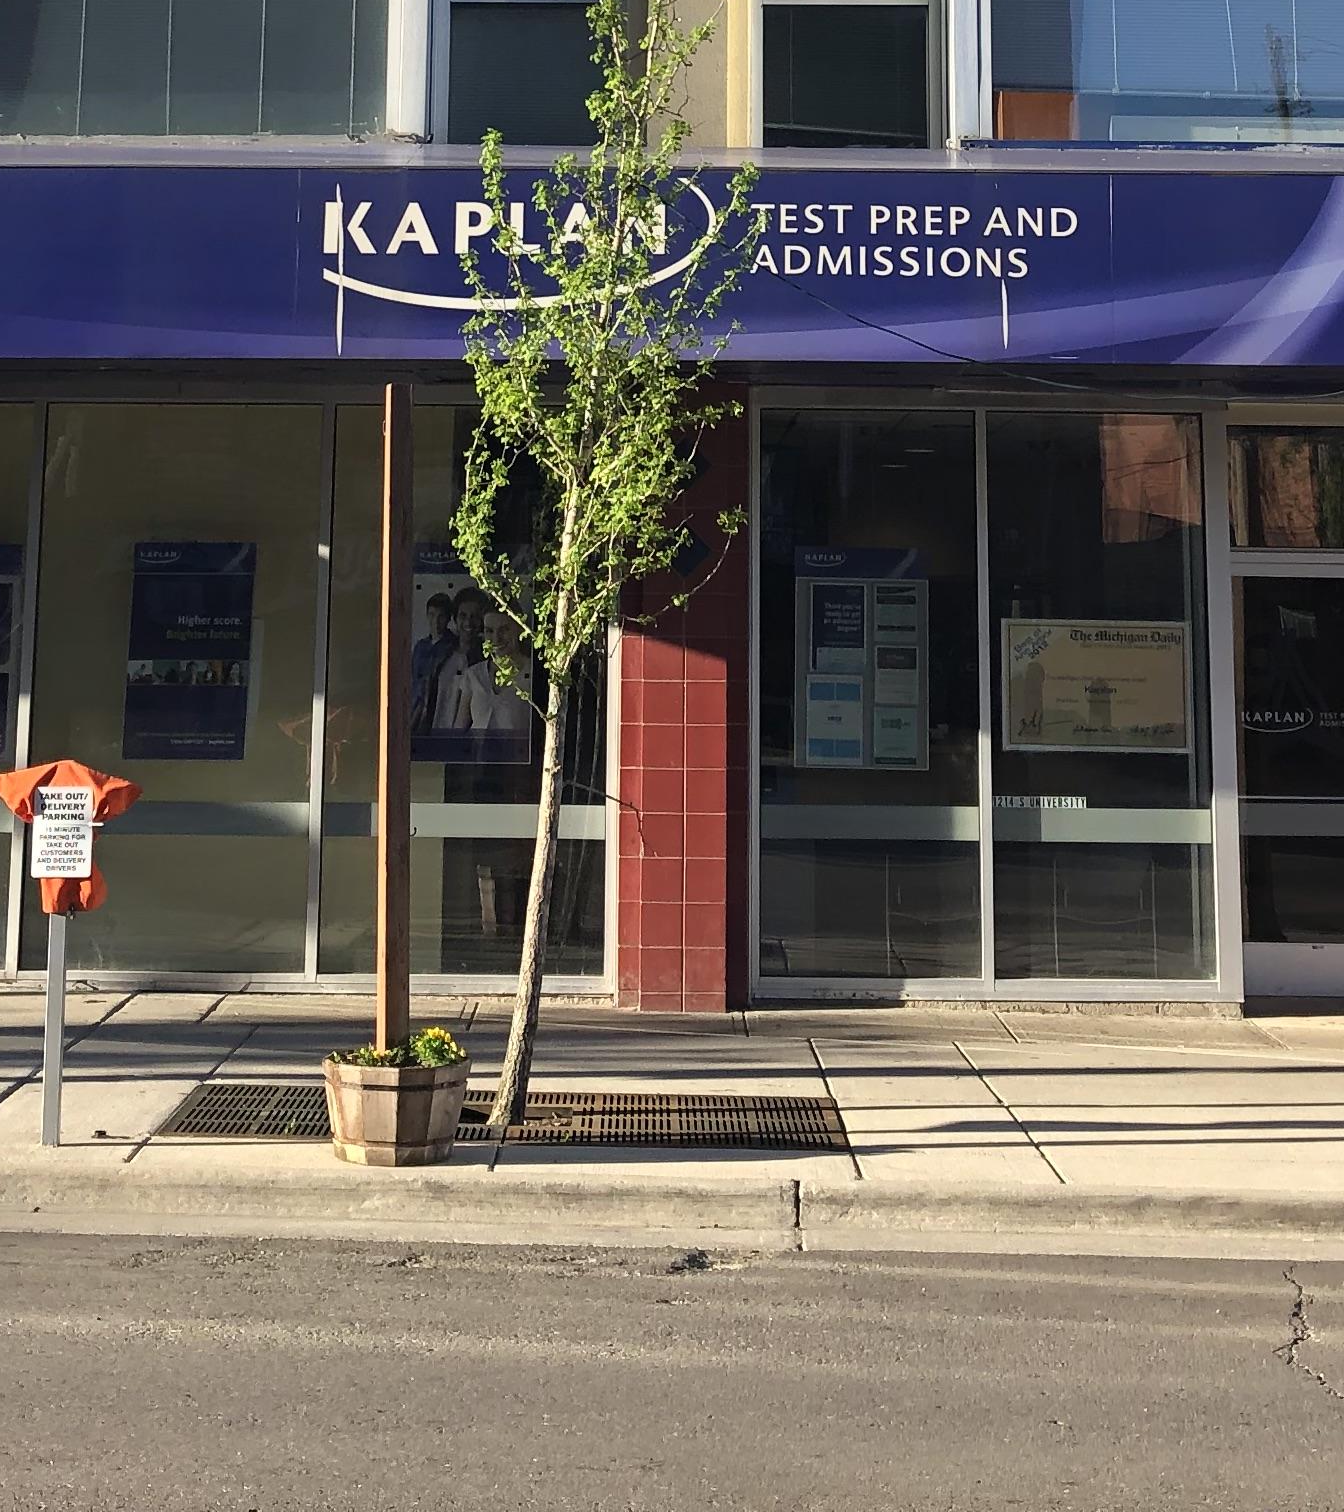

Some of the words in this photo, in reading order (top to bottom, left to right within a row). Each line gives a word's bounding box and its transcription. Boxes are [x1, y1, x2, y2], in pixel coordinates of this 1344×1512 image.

[750, 203, 853, 234] TEST
[869, 205, 970, 236] PREP
[983, 206, 1078, 237] AND
[750, 244, 1029, 279] ADMISSIONS
[177, 615, 211, 626] Higher
[213, 616, 243, 626] score.
[1069, 629, 1092, 641] The
[1094, 630, 1148, 643] Michigan
[1150, 631, 1182, 644] Daily
[1242, 711, 1306, 723] KAPLAN
[65, 793, 89, 801] OUT/
[992, 796, 1013, 807] 1214
[1019, 796, 1025, 807] S
[1029, 796, 1086, 808] UNIVERSITY
[40, 803, 86, 811] DELIVERY
[42, 813, 85, 821] PARKING
